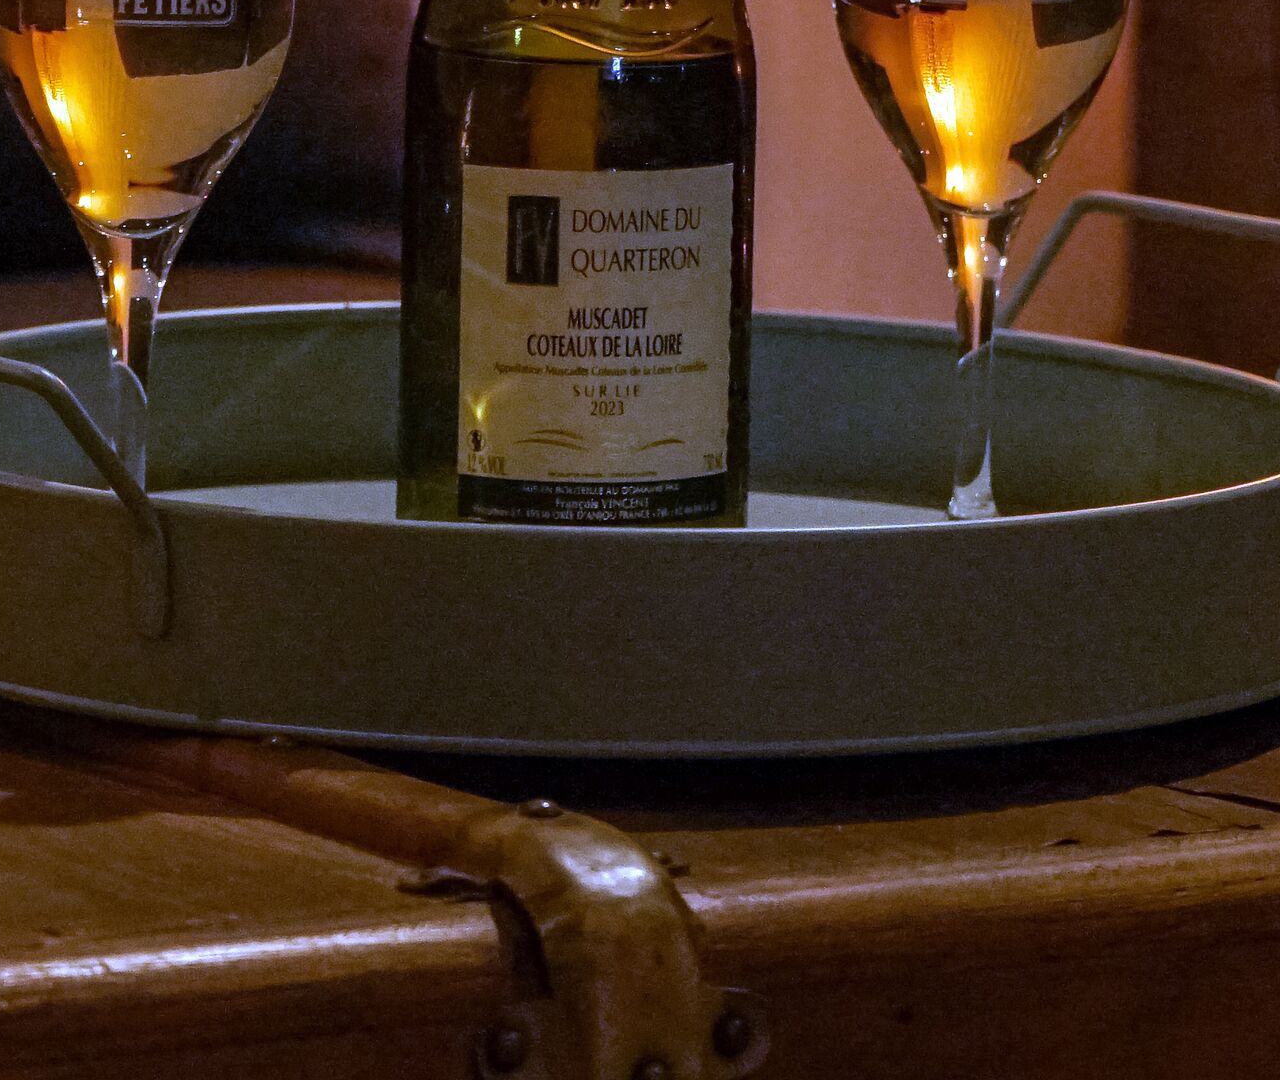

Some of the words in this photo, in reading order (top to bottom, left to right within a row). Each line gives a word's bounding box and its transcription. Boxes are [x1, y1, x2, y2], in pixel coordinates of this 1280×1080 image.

[572, 207, 669, 233] DOMAINE
[675, 206, 702, 231] DU
[570, 245, 701, 277] QUARTERON
[567, 307, 648, 330] MUSCADET
[526, 334, 598, 358] COTEAUX
[602, 334, 622, 357] DE
[625, 334, 643, 357] LA
[645, 333, 683, 356] LOIRE
[573, 384, 608, 398] SUR
[615, 384, 641, 398] LIE
[590, 401, 625, 416] 2023
